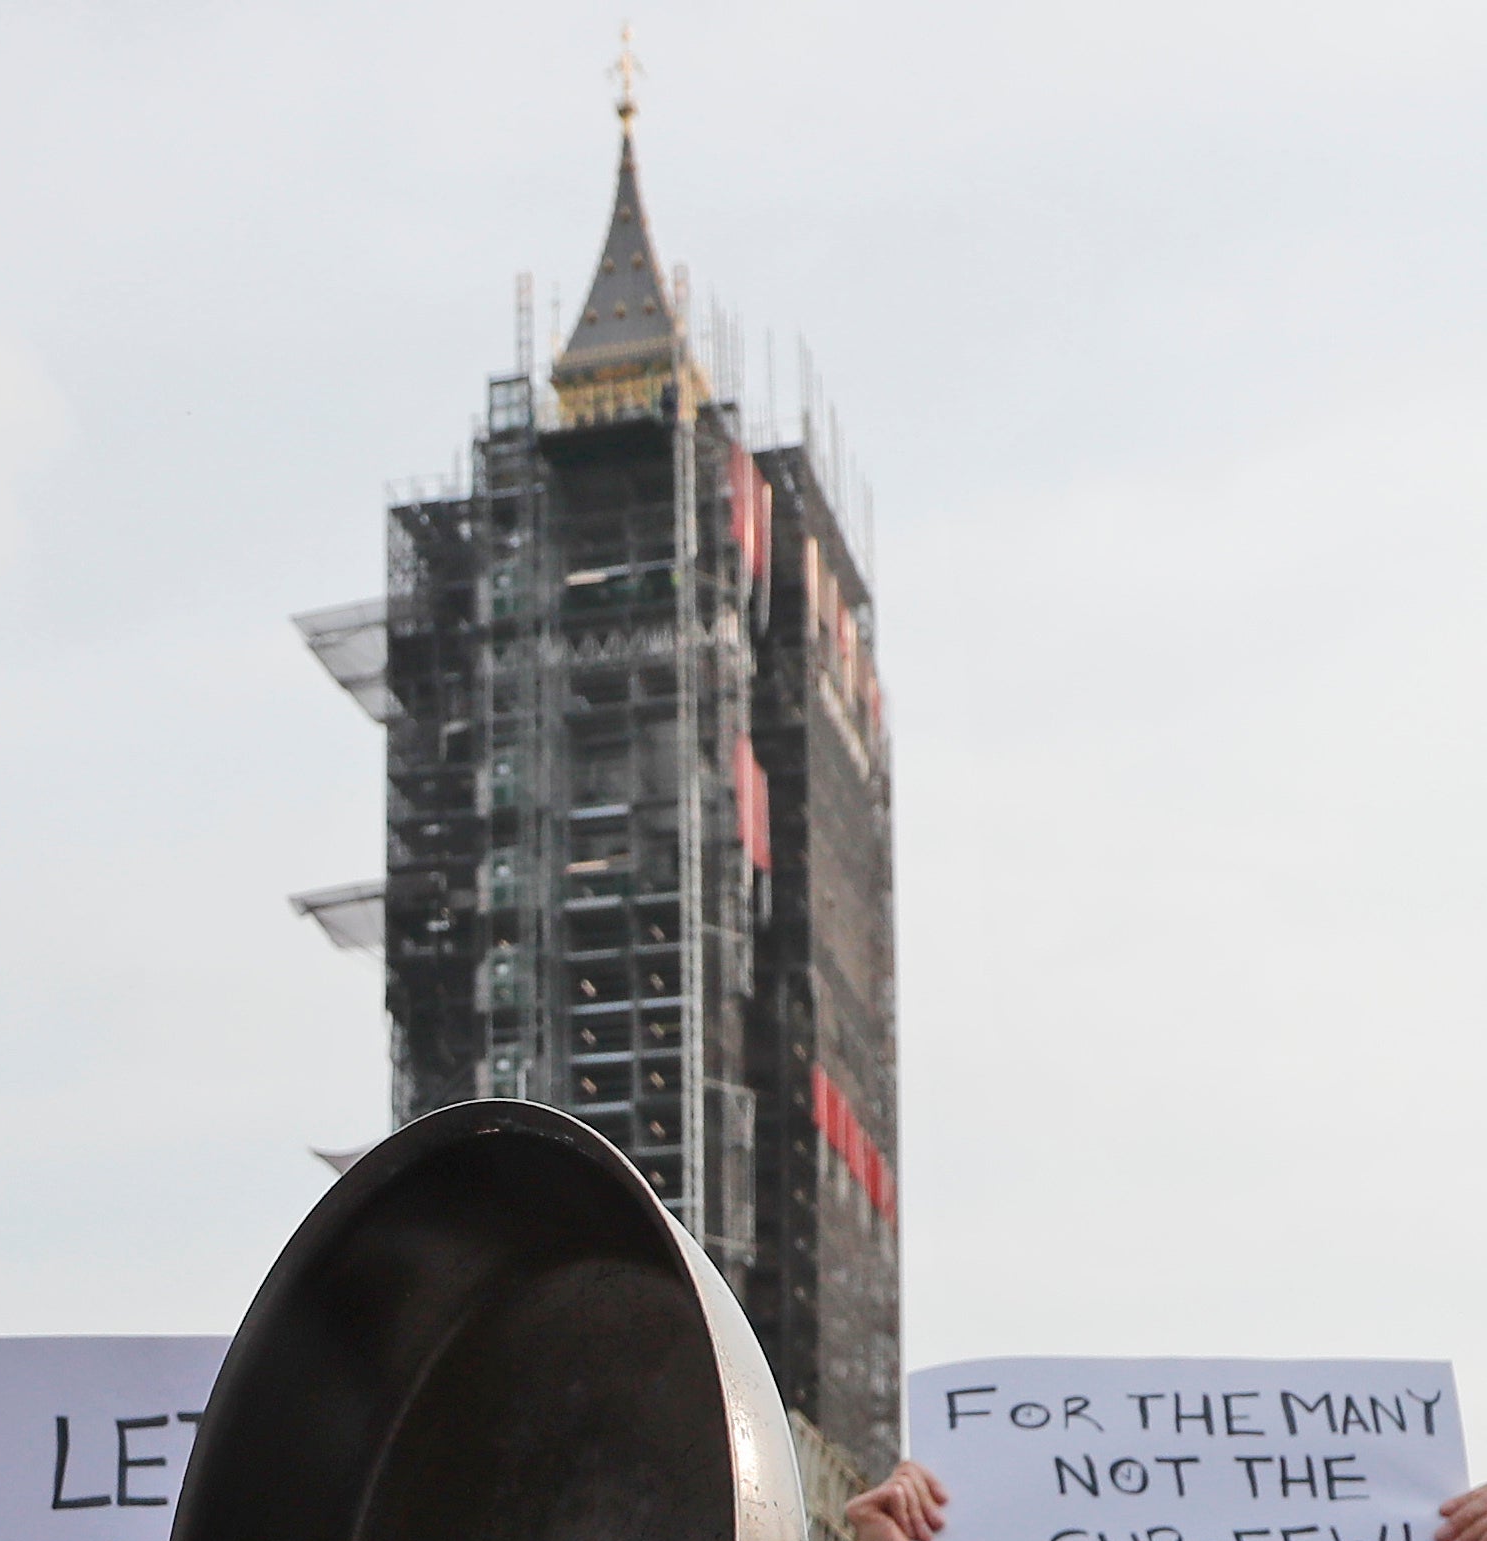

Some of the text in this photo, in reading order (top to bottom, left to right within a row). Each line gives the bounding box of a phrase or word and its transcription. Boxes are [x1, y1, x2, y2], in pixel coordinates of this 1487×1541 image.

[945, 1385, 1443, 1437] FOR THE MANY
[1052, 1453, 1371, 1502] NOT THE
